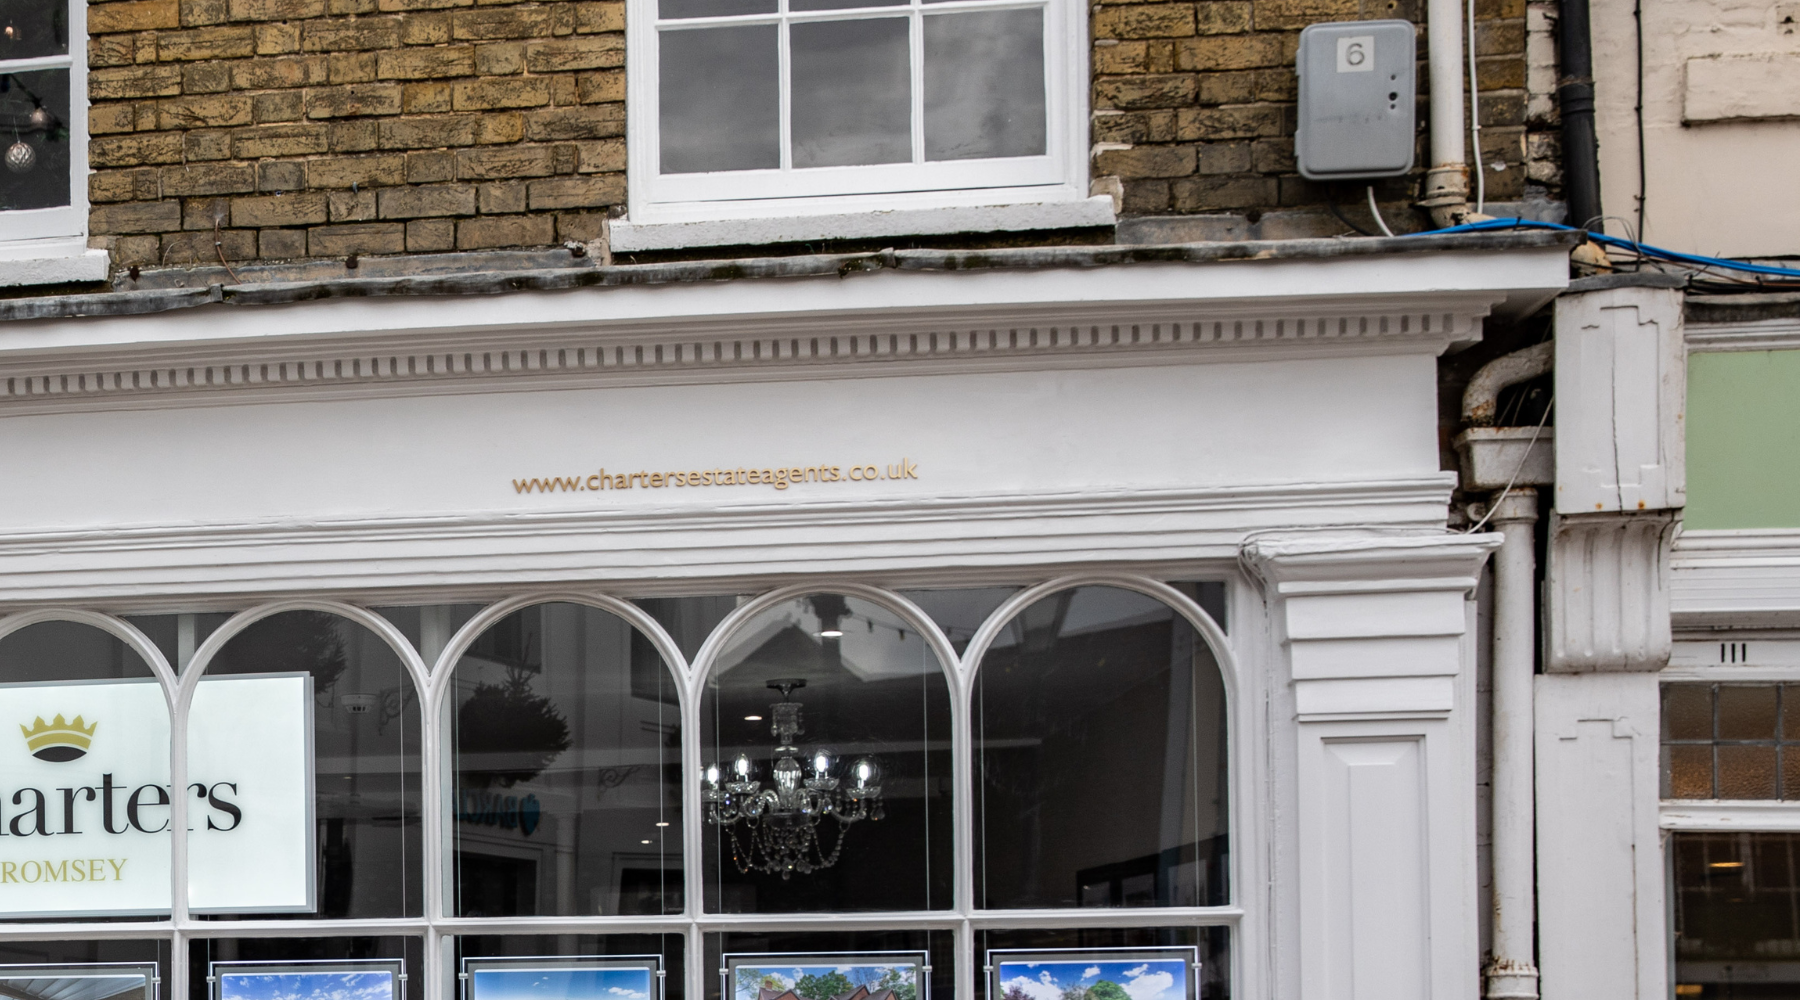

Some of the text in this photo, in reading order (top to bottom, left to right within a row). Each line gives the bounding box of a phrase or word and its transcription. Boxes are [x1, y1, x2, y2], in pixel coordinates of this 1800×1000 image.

[1345, 43, 1366, 66] 6
[512, 456, 919, 494] www.chartersestateagents.co.uk
[0, 857, 128, 884] ROMSEY
